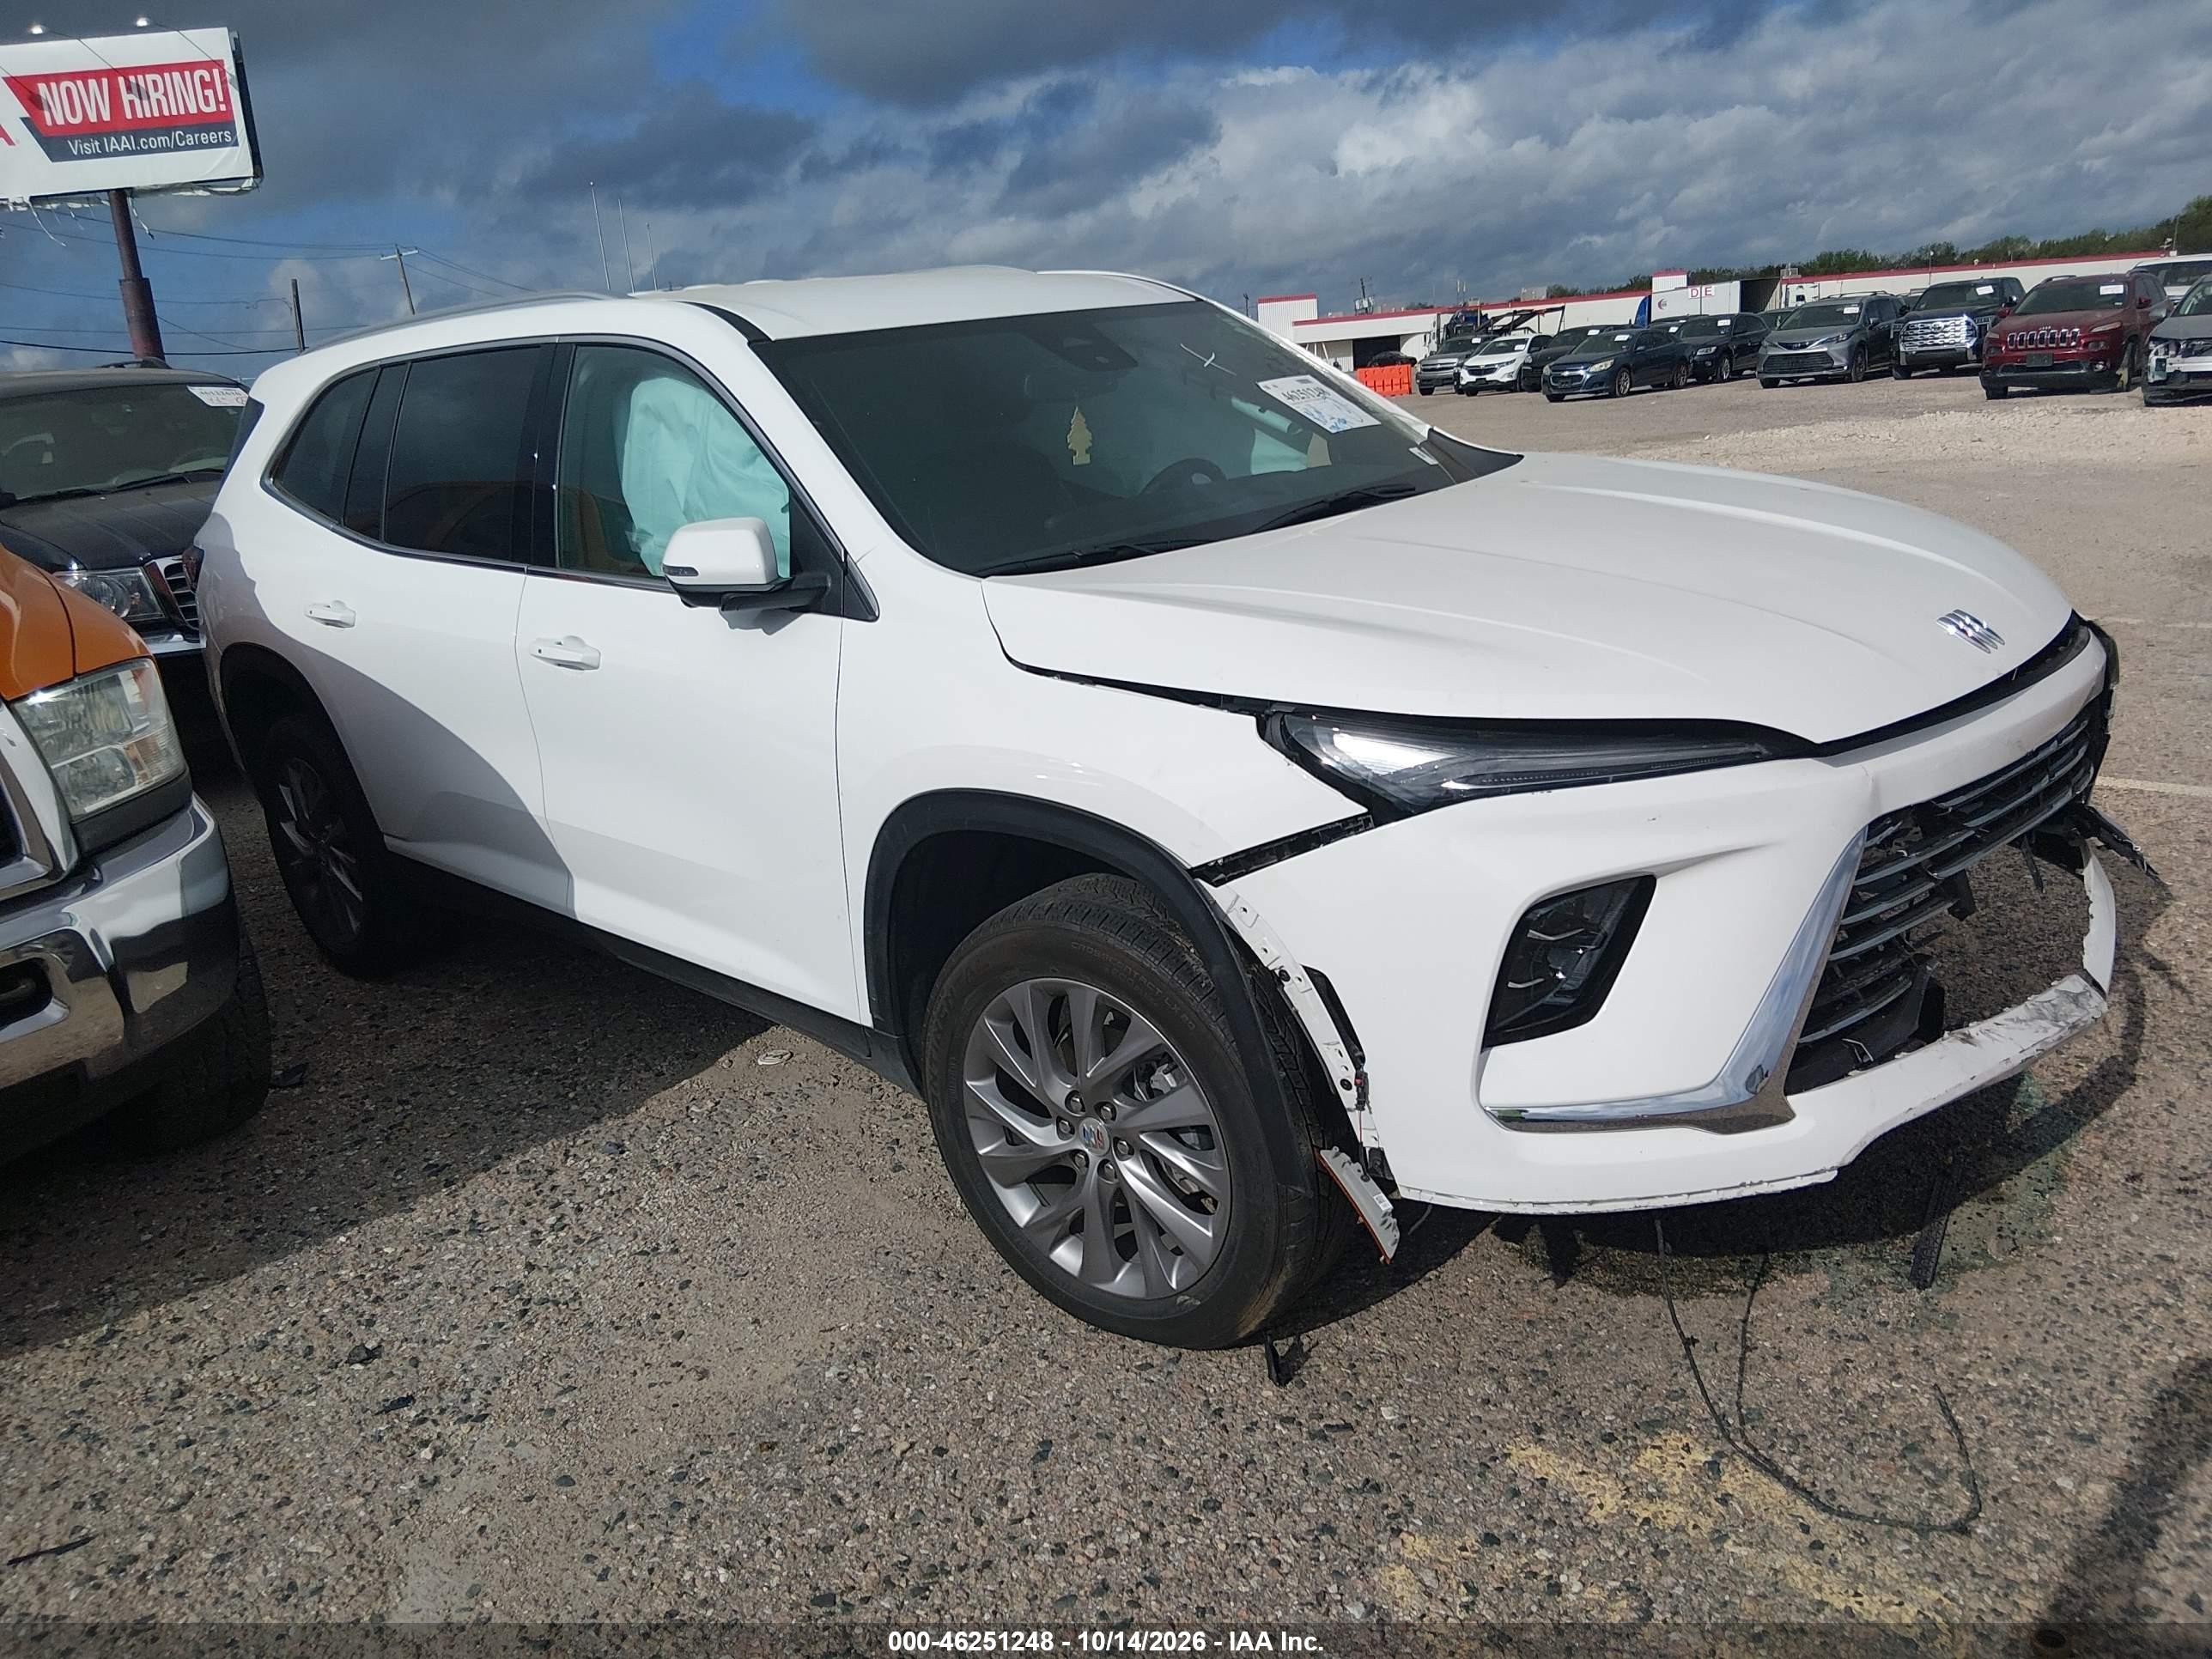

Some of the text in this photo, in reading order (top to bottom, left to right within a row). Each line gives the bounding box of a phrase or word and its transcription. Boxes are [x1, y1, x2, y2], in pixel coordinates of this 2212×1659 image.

[38, 68, 227, 126] NOW HIRING!
[68, 130, 233, 155] Visit IAAI.com/Careers
[1690, 286, 1712, 298] D E
